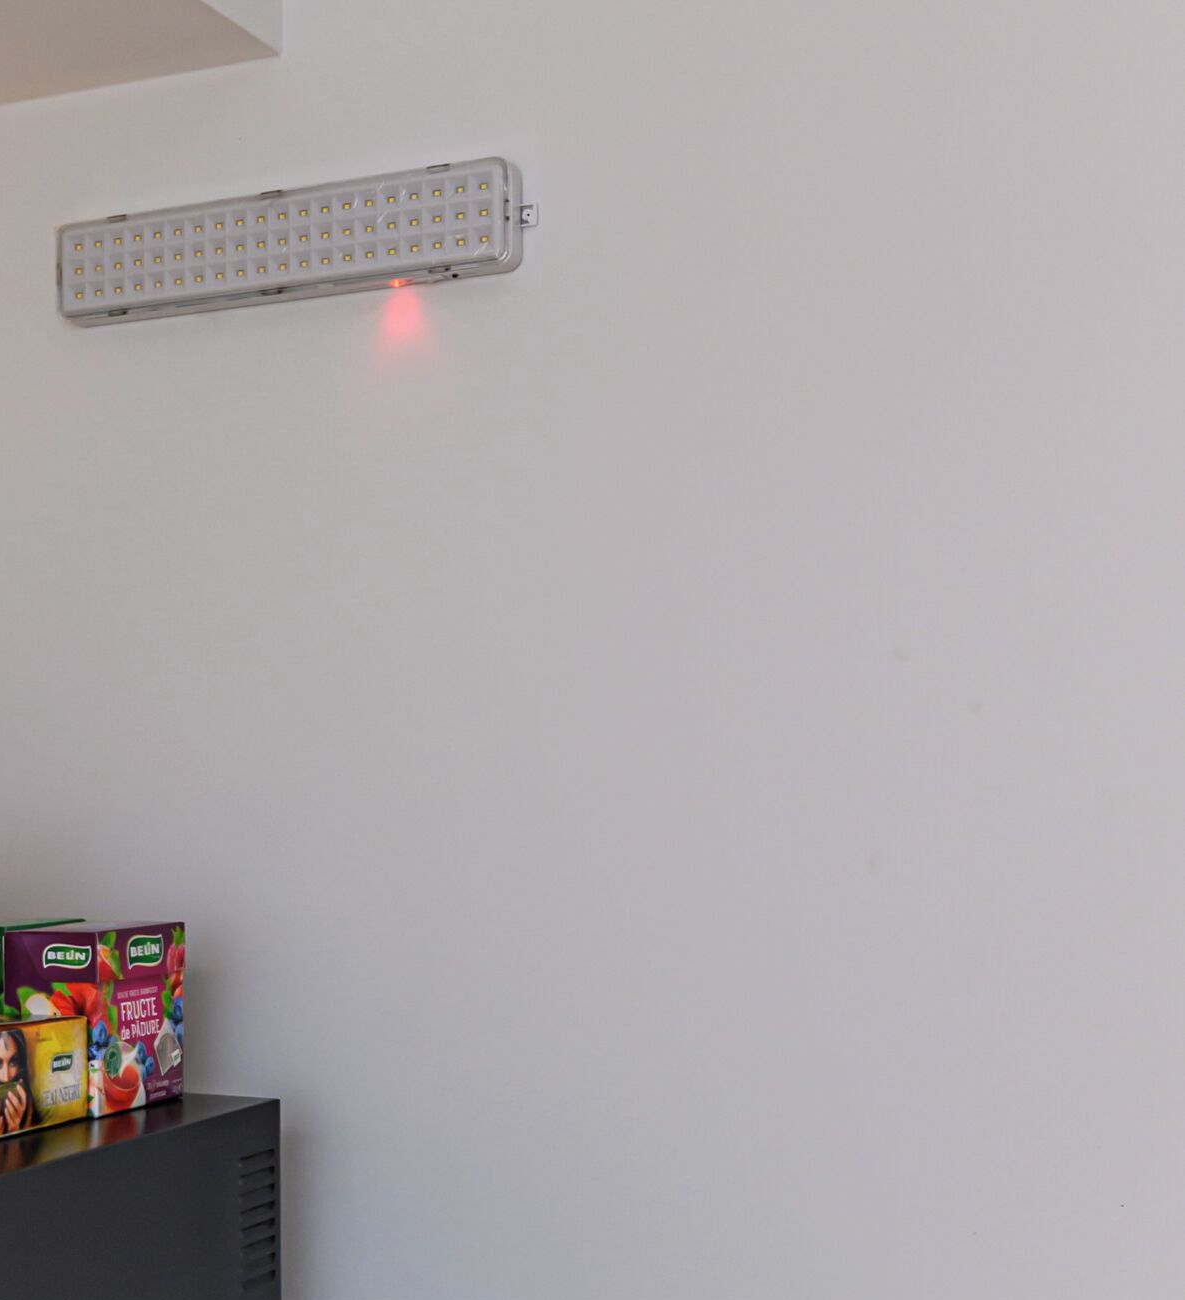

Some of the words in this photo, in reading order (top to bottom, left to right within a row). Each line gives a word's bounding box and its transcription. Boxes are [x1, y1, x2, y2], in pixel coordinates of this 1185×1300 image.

[47, 950, 86, 961] BELIN
[130, 942, 160, 958] BELIN
[121, 997, 157, 1022] FRUCTE
[121, 1026, 130, 1040] de
